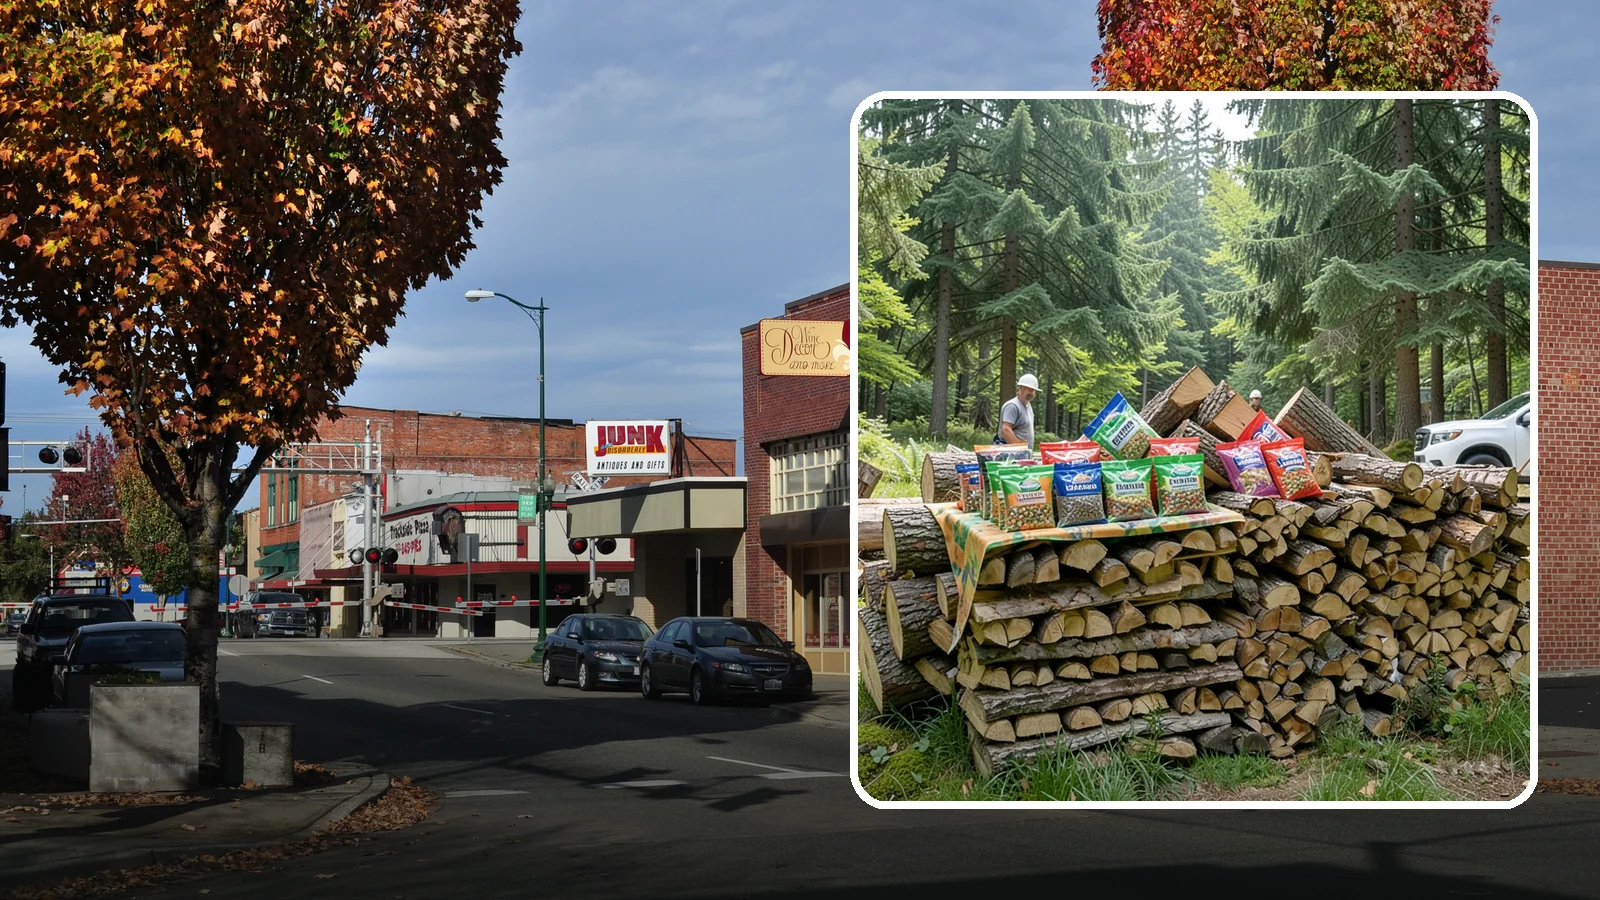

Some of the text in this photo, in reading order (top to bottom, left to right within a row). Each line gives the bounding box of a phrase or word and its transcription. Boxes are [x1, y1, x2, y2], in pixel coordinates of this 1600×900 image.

[595, 425, 665, 457] JUNK
[607, 446, 646, 454] DISORDERLY
[597, 460, 665, 470] ANTIQUES AND GIFTS
[390, 519, 429, 540] Trackside Pizza
